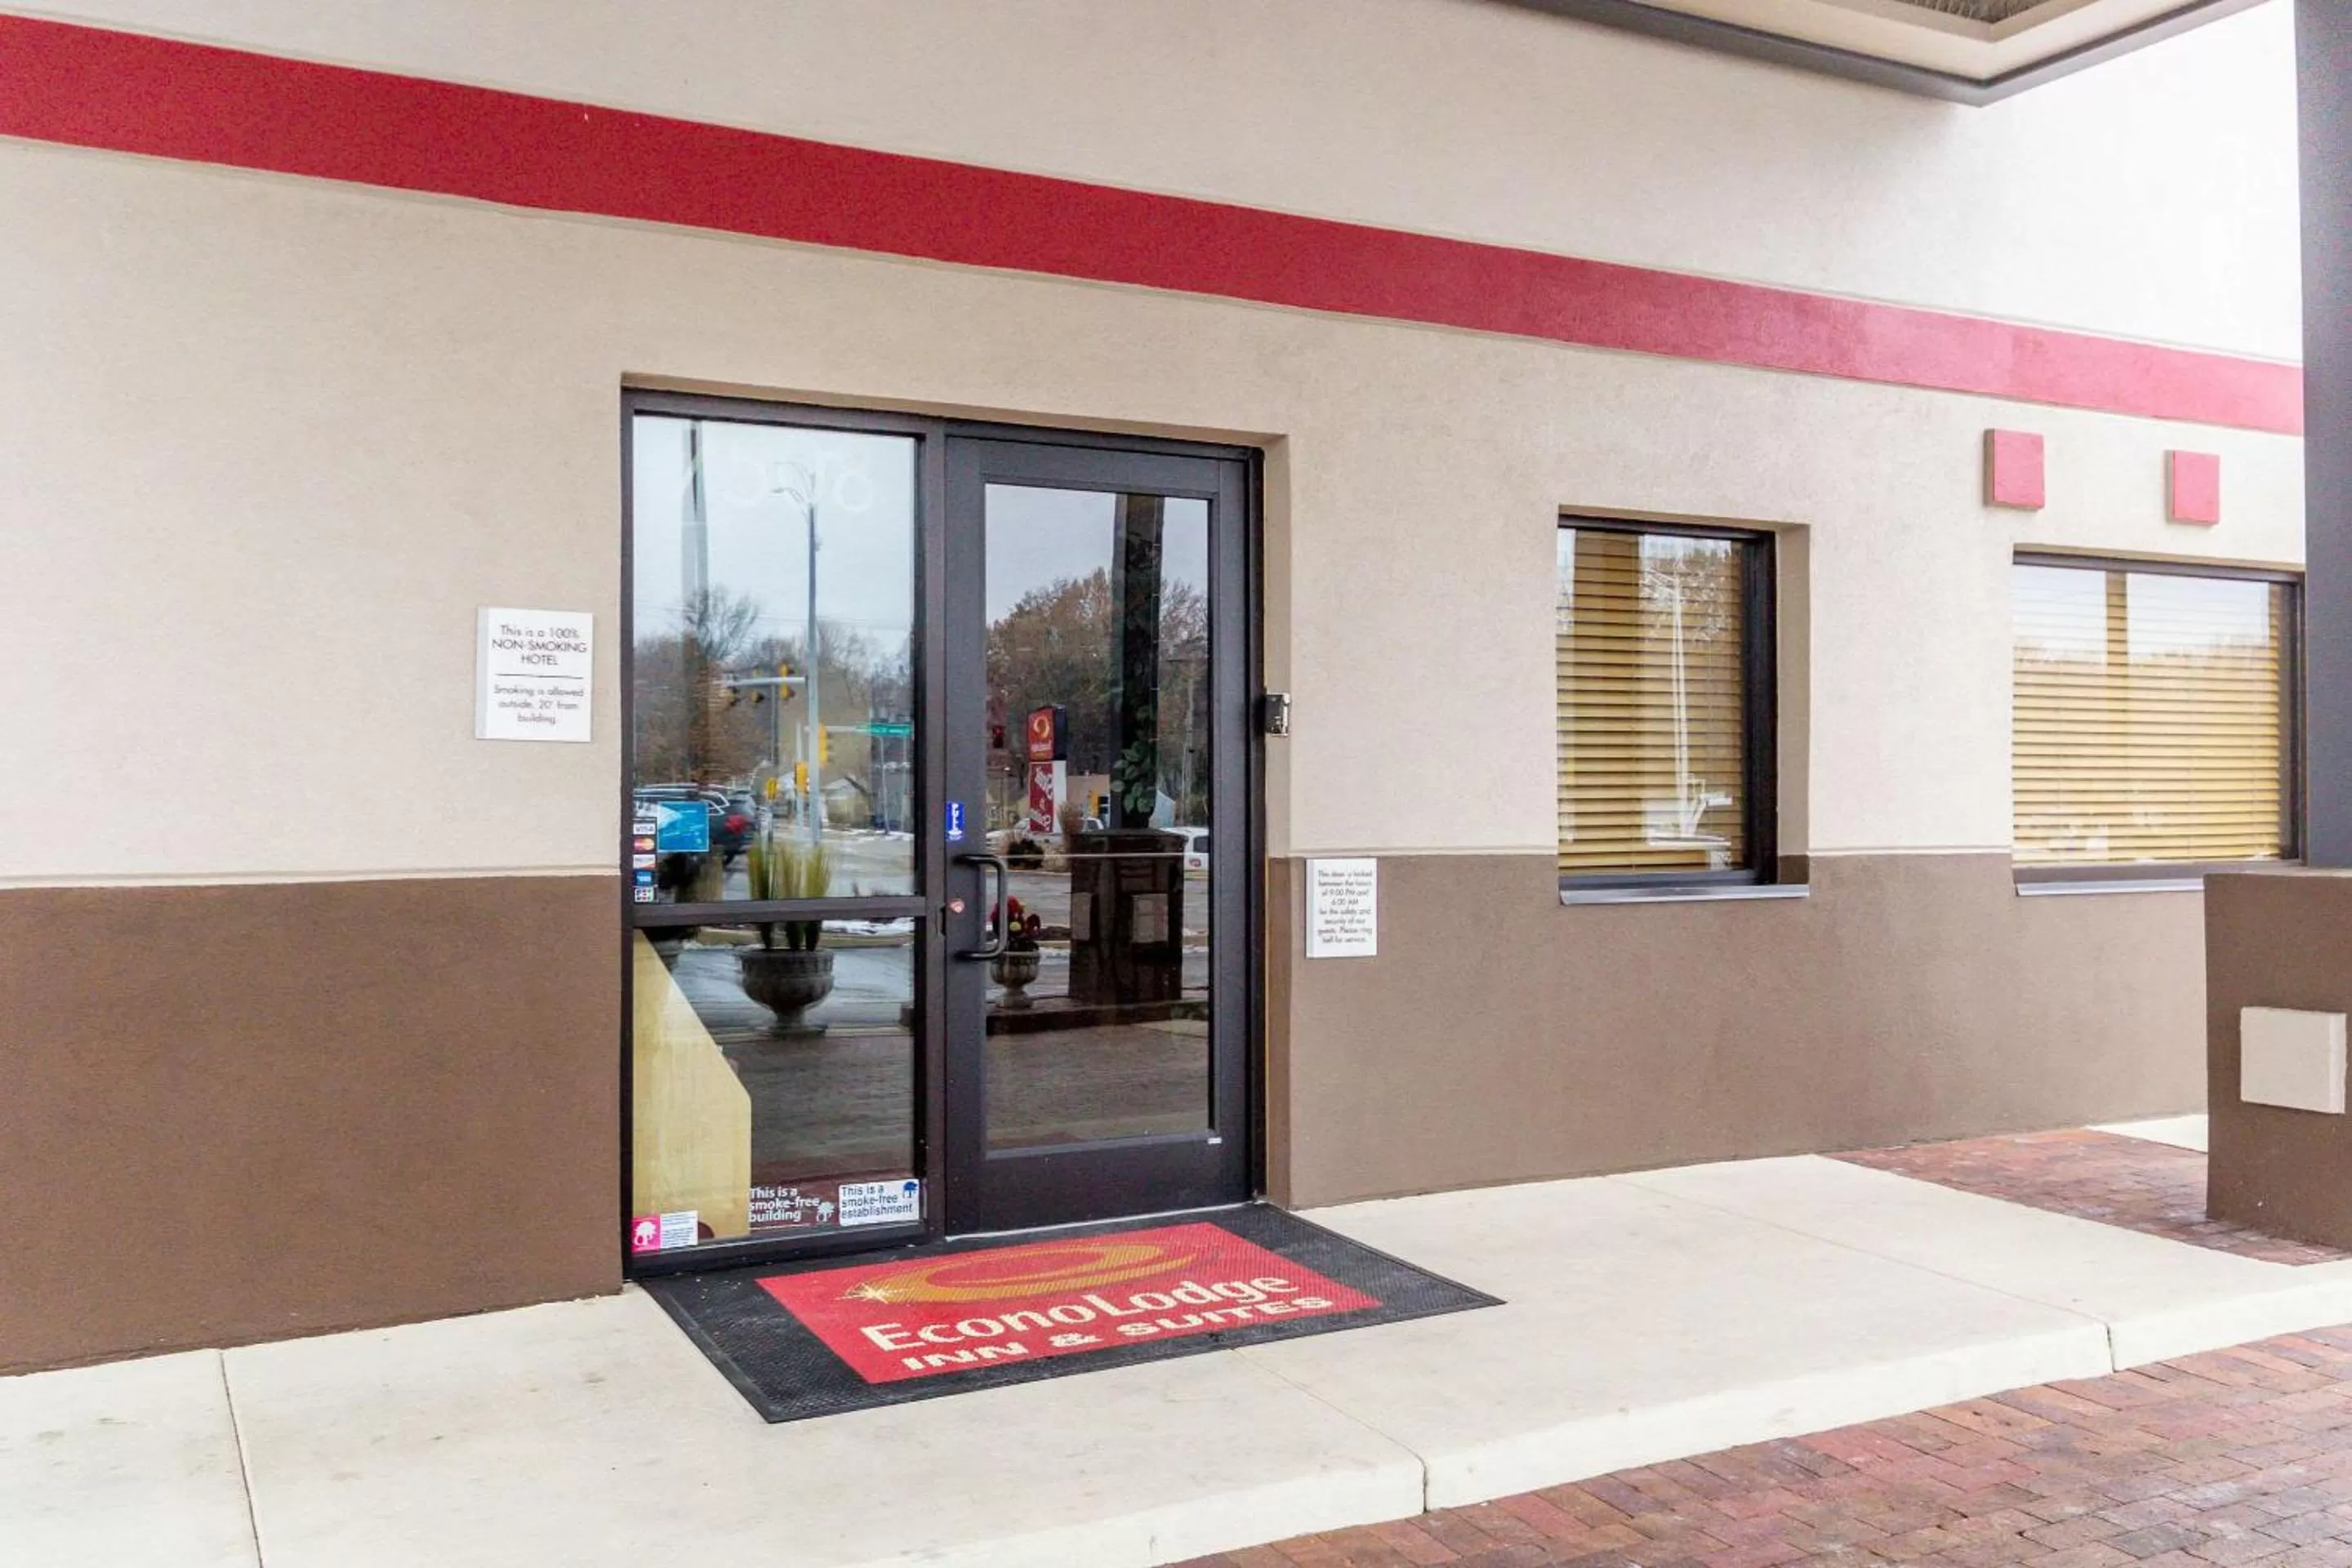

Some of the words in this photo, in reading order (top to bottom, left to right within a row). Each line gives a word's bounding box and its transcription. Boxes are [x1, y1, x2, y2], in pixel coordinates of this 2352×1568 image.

[501, 624, 522, 636] This
[526, 627, 533, 637] is
[537, 629, 546, 637] a
[549, 626, 580, 639] 100%
[520, 653, 559, 666] HOTEL
[493, 684, 534, 697] Smoking
[546, 686, 585, 697] allowed
[557, 701, 578, 710] from
[1317, 869, 1330, 877] This
[1348, 898, 1359, 906] AM
[749, 1187, 775, 1199] This
[777, 1186, 789, 1196] is
[790, 1187, 798, 1196] a
[841, 1186, 863, 1196] This
[866, 1186, 875, 1195] is
[877, 1185, 884, 1194] a
[748, 1196, 821, 1210] smoke-free
[841, 1194, 898, 1209] smoke-free
[748, 1209, 802, 1222] building
[841, 1203, 913, 1219] establishment
[859, 1276, 1301, 1352] EconoLodge
[901, 1341, 1029, 1372] INN
[1048, 1331, 1103, 1349] &
[1116, 1295, 1334, 1337] SUITES
